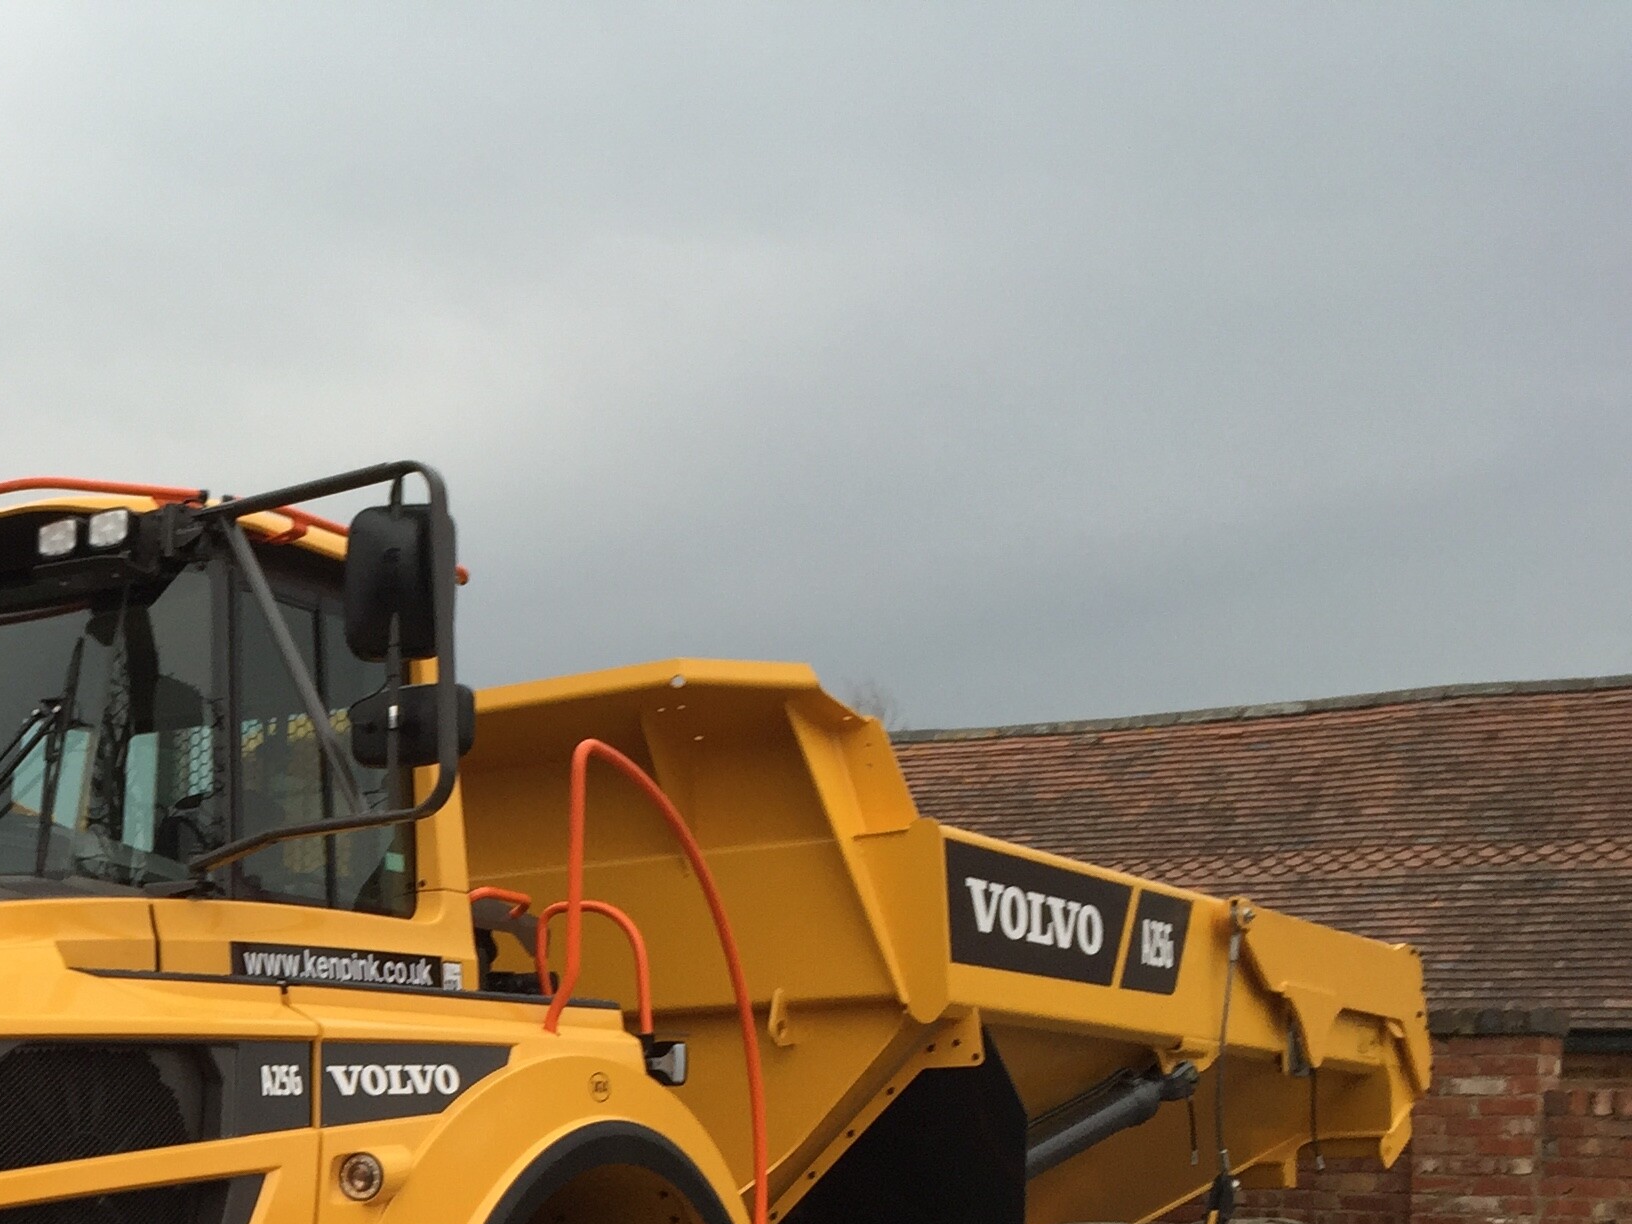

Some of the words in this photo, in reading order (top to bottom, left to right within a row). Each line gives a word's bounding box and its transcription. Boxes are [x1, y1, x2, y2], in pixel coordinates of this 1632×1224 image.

[965, 877, 1104, 956] VOLVO
[243, 949, 434, 986] www.kenpink.co.uk
[260, 1064, 303, 1097] A25G
[326, 1063, 461, 1096] VOLVO
